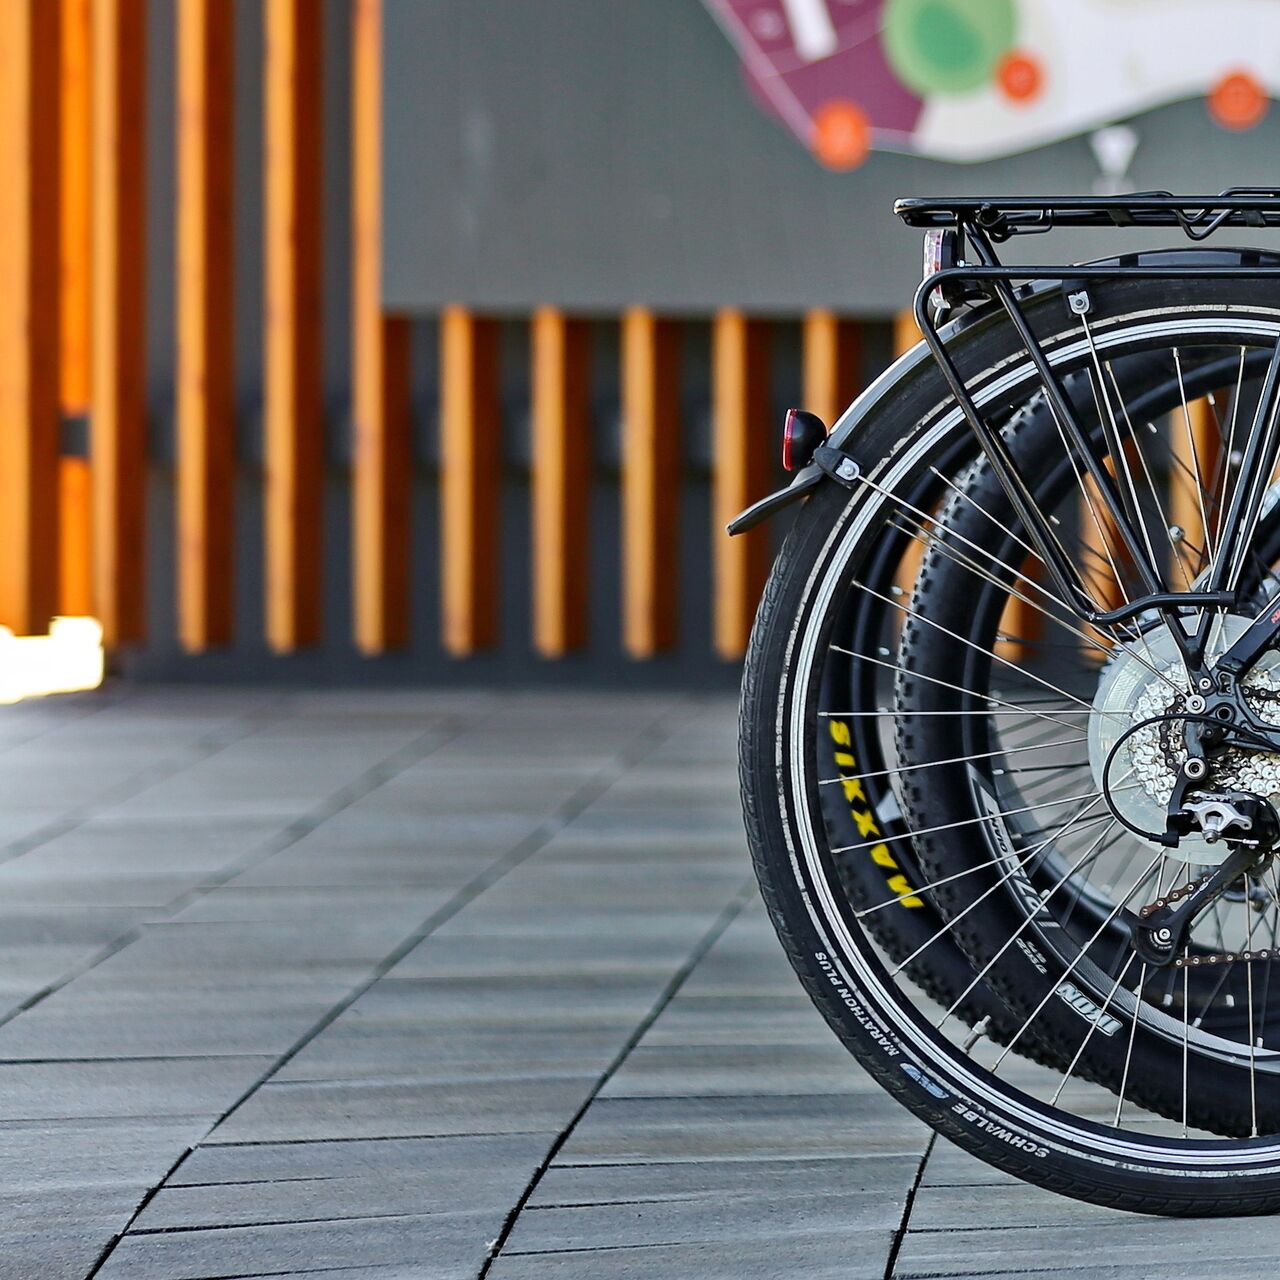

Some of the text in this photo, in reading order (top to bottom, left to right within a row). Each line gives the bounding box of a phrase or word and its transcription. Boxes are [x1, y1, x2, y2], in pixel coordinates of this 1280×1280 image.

[829, 720, 925, 908] MAXXIS
[815, 951, 900, 1057] MARATHON PLUS
[951, 1102, 1050, 1159] SCHWALBE
